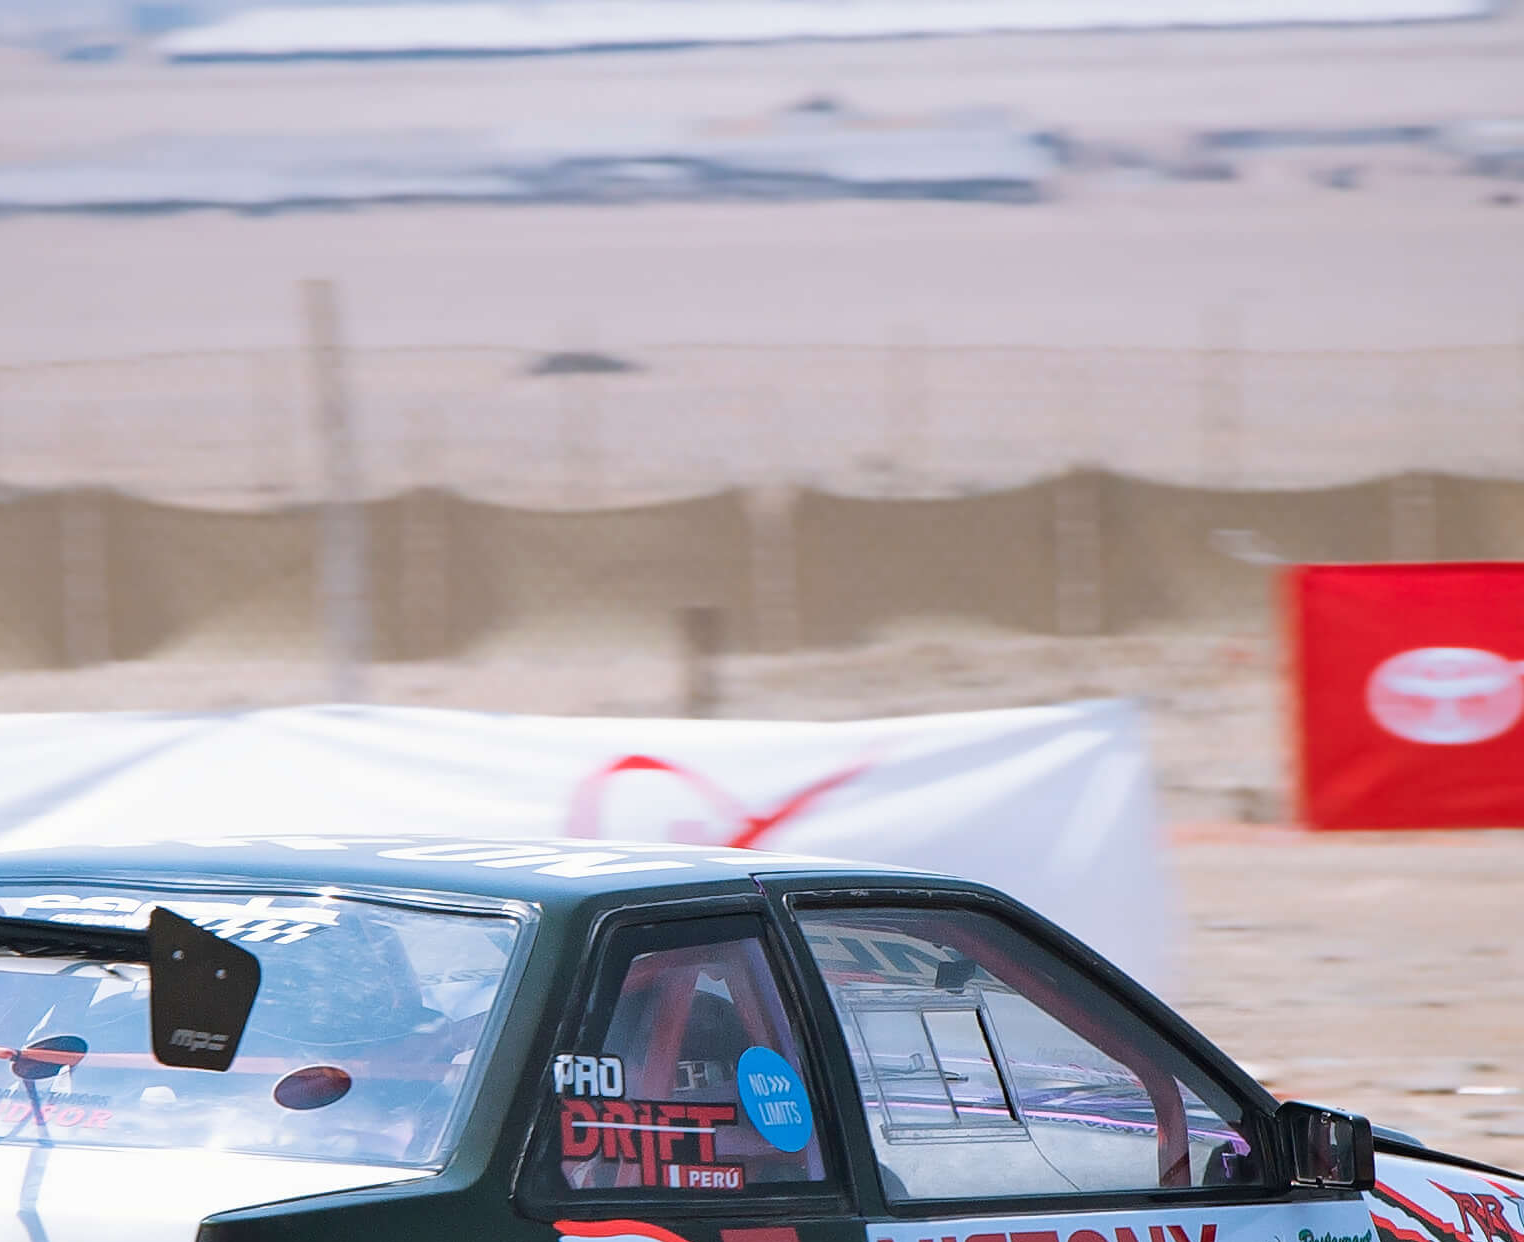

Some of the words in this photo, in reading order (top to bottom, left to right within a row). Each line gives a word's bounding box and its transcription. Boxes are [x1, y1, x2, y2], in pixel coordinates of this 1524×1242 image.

[554, 1054, 624, 1098] PRO
[758, 1101, 803, 1126] LIMITS
[561, 1100, 735, 1187] DRIFT
[688, 1166, 741, 1189] PERÚ
